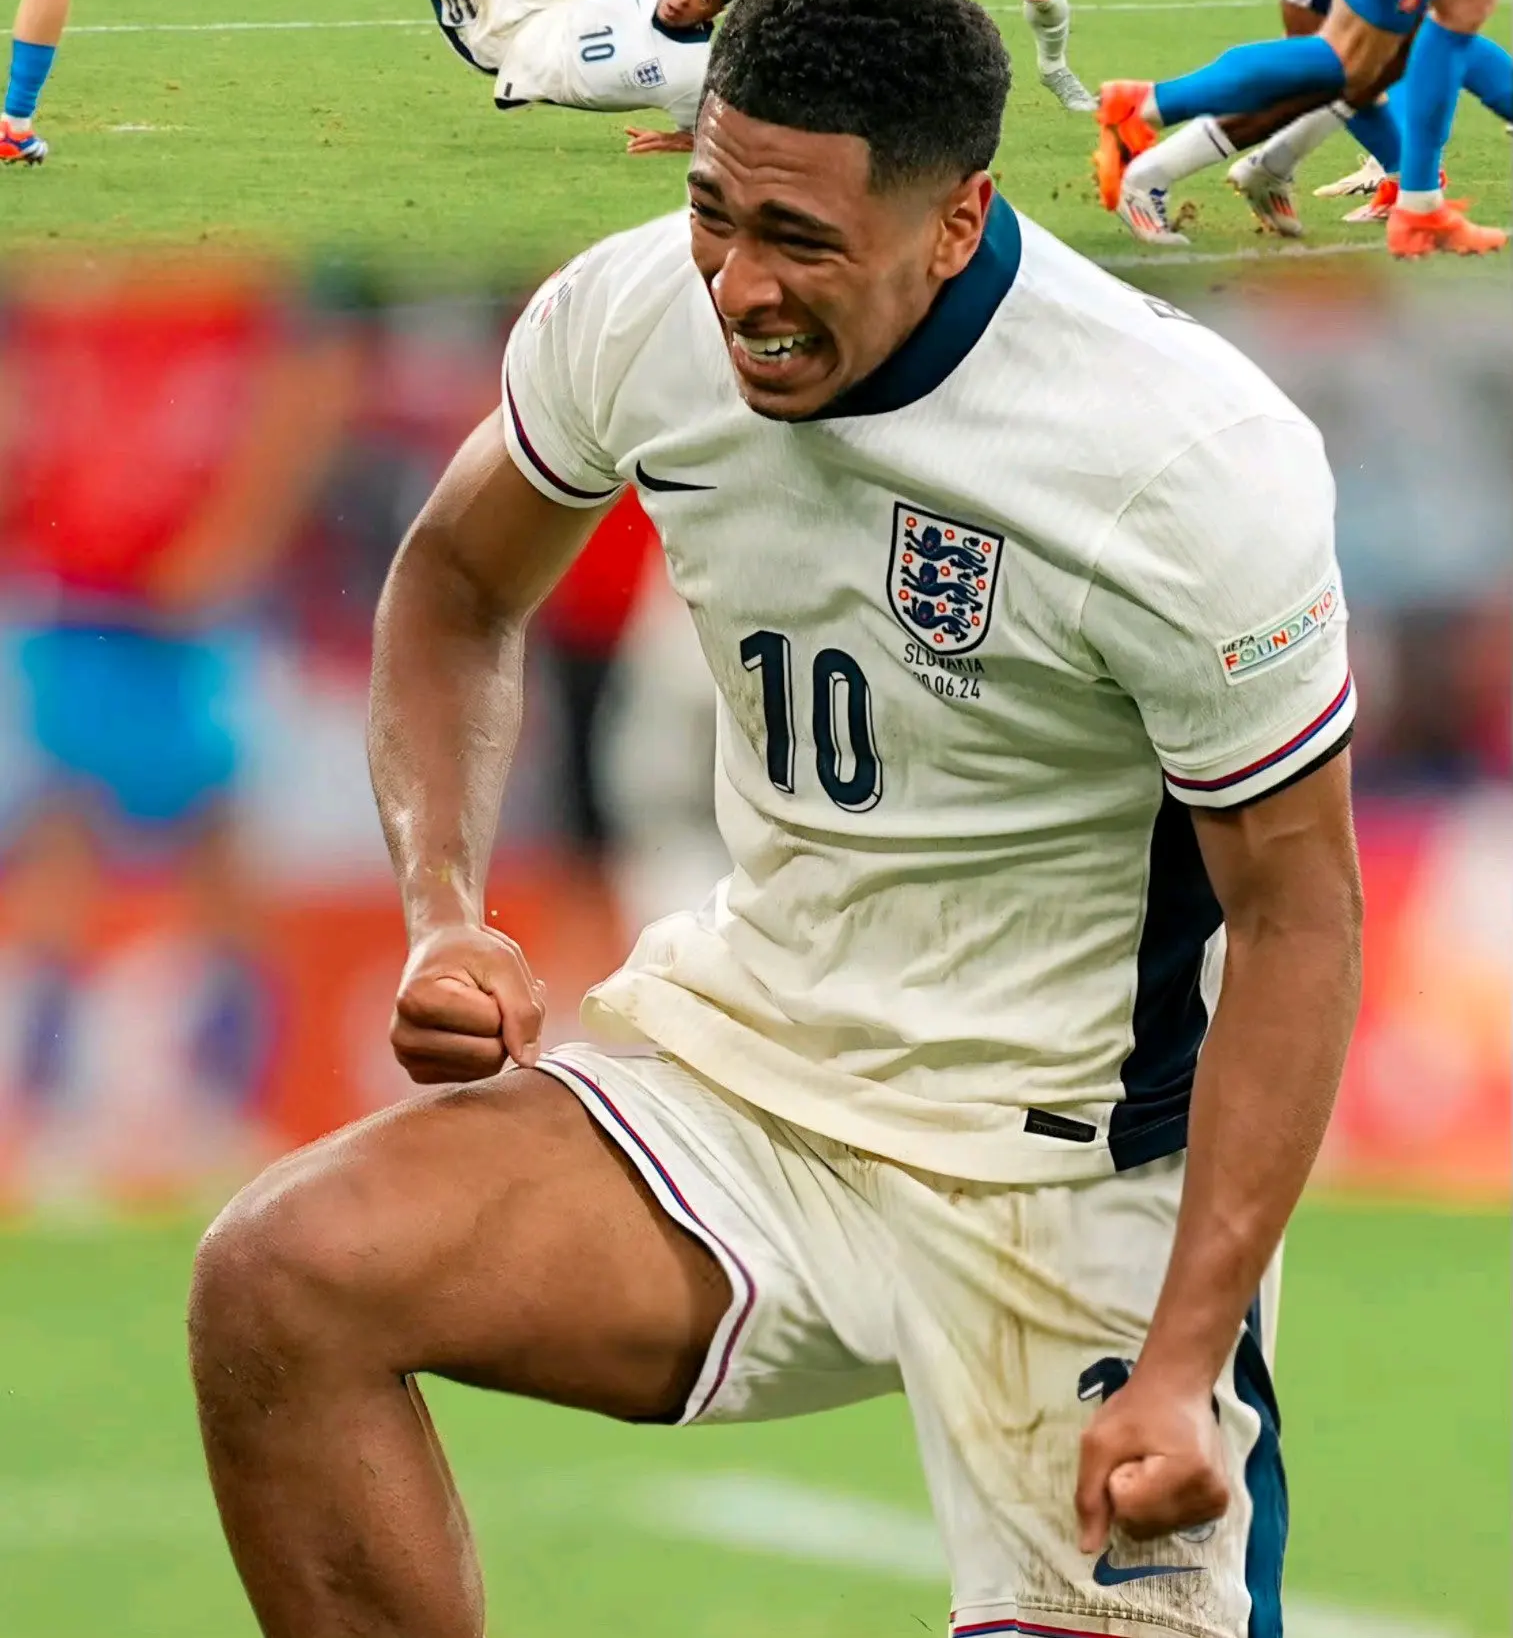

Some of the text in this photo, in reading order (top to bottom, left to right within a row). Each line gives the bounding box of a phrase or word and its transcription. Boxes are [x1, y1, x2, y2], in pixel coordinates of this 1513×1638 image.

[578, 25, 616, 62] 10
[1222, 635, 1256, 655] UEFA
[1224, 584, 1337, 671] FOUNDATIO
[739, 629, 884, 814] 10
